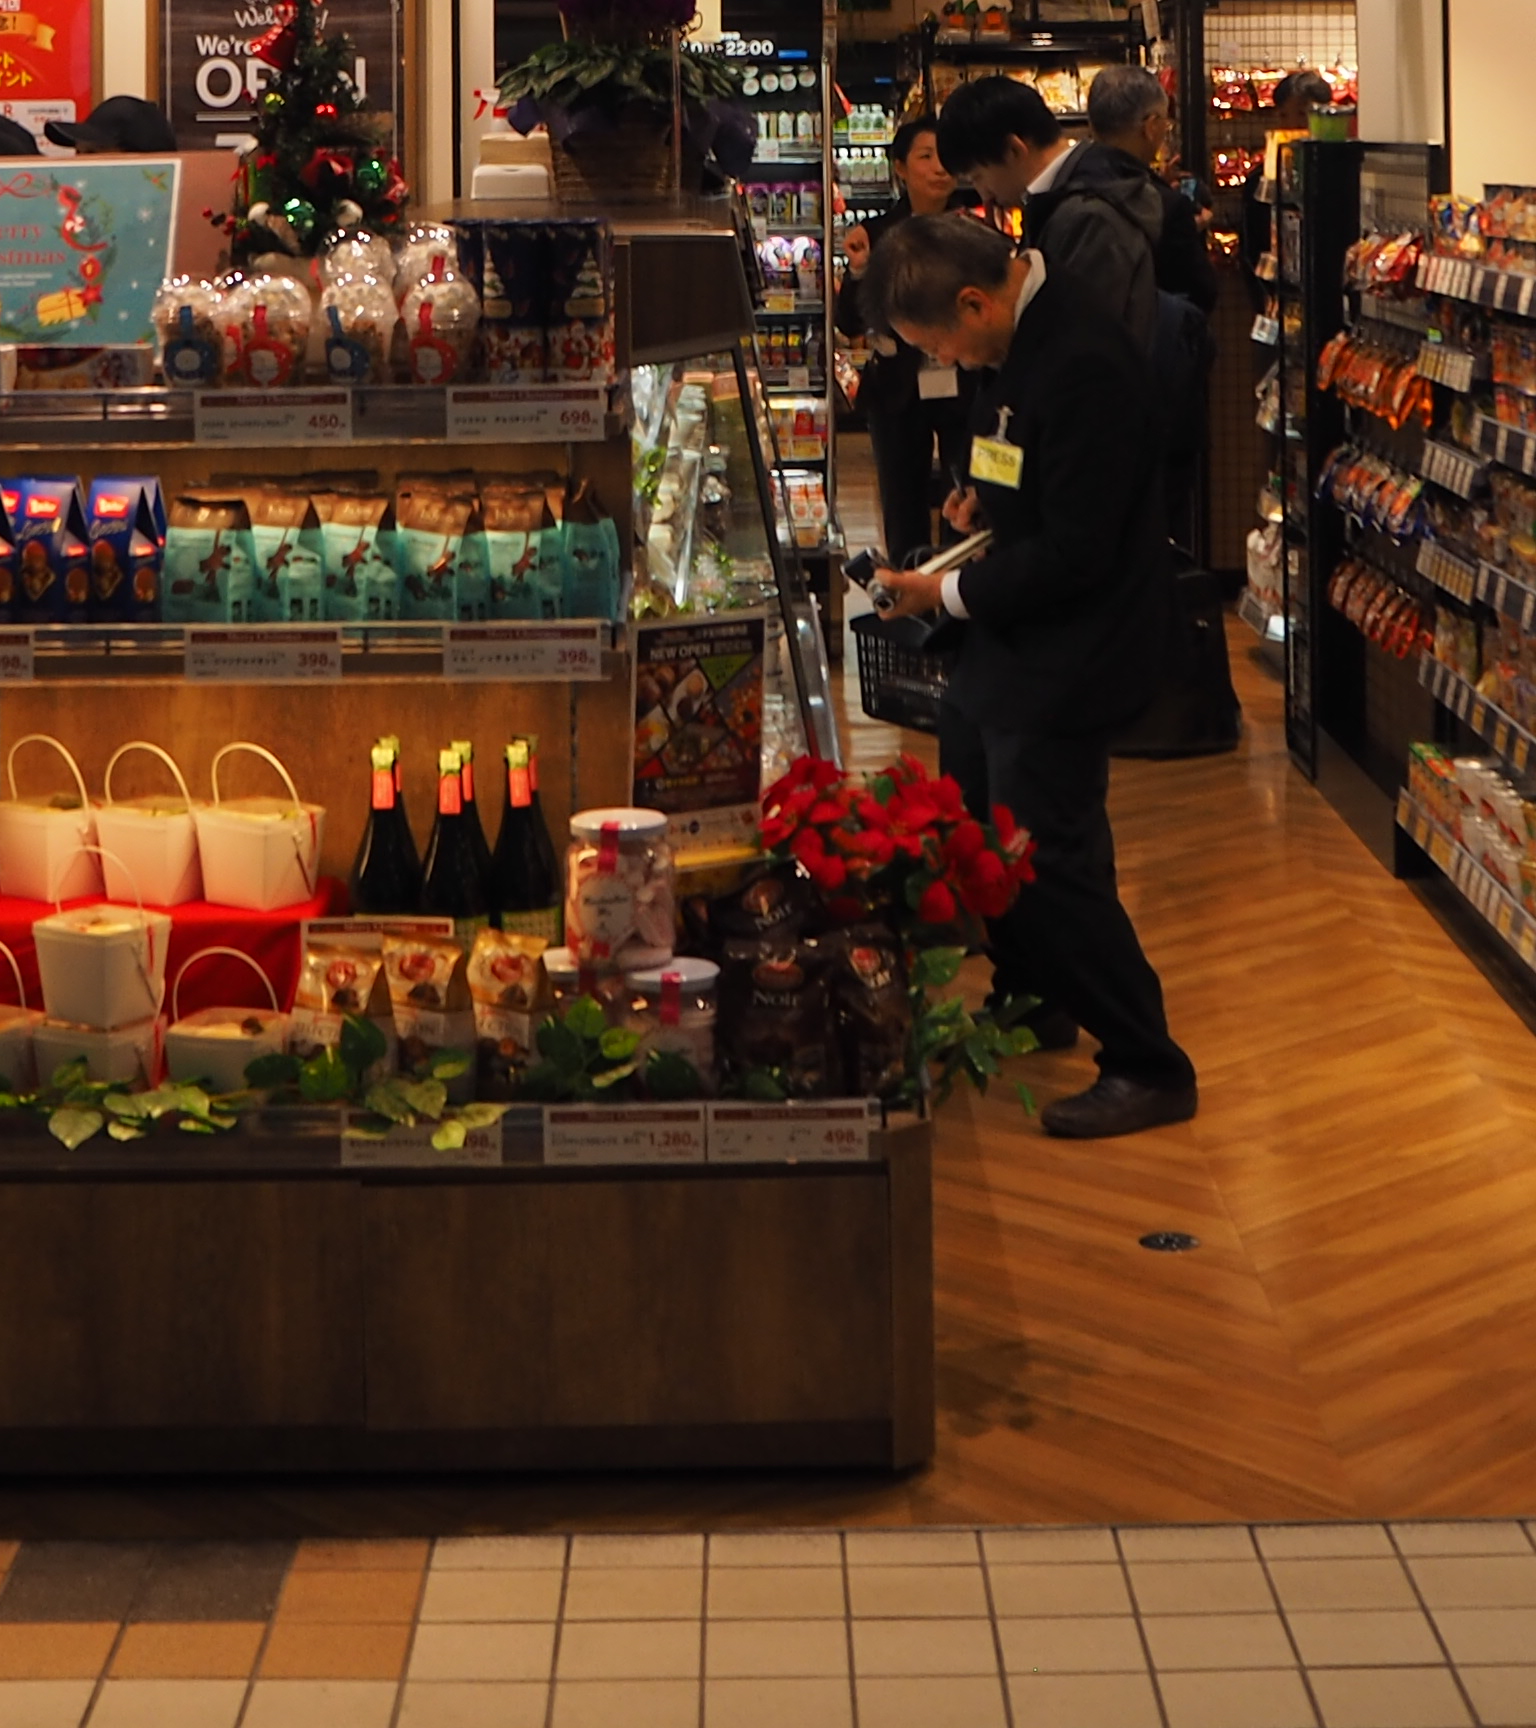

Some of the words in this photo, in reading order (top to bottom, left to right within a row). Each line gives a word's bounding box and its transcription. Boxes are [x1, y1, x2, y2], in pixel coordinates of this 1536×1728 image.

[308, 413, 339, 429] 450
[560, 410, 591, 426] 698
[297, 652, 330, 667] 398
[557, 649, 590, 665] 398
[753, 989, 799, 1007] Noir
[824, 1128, 856, 1144] 498
